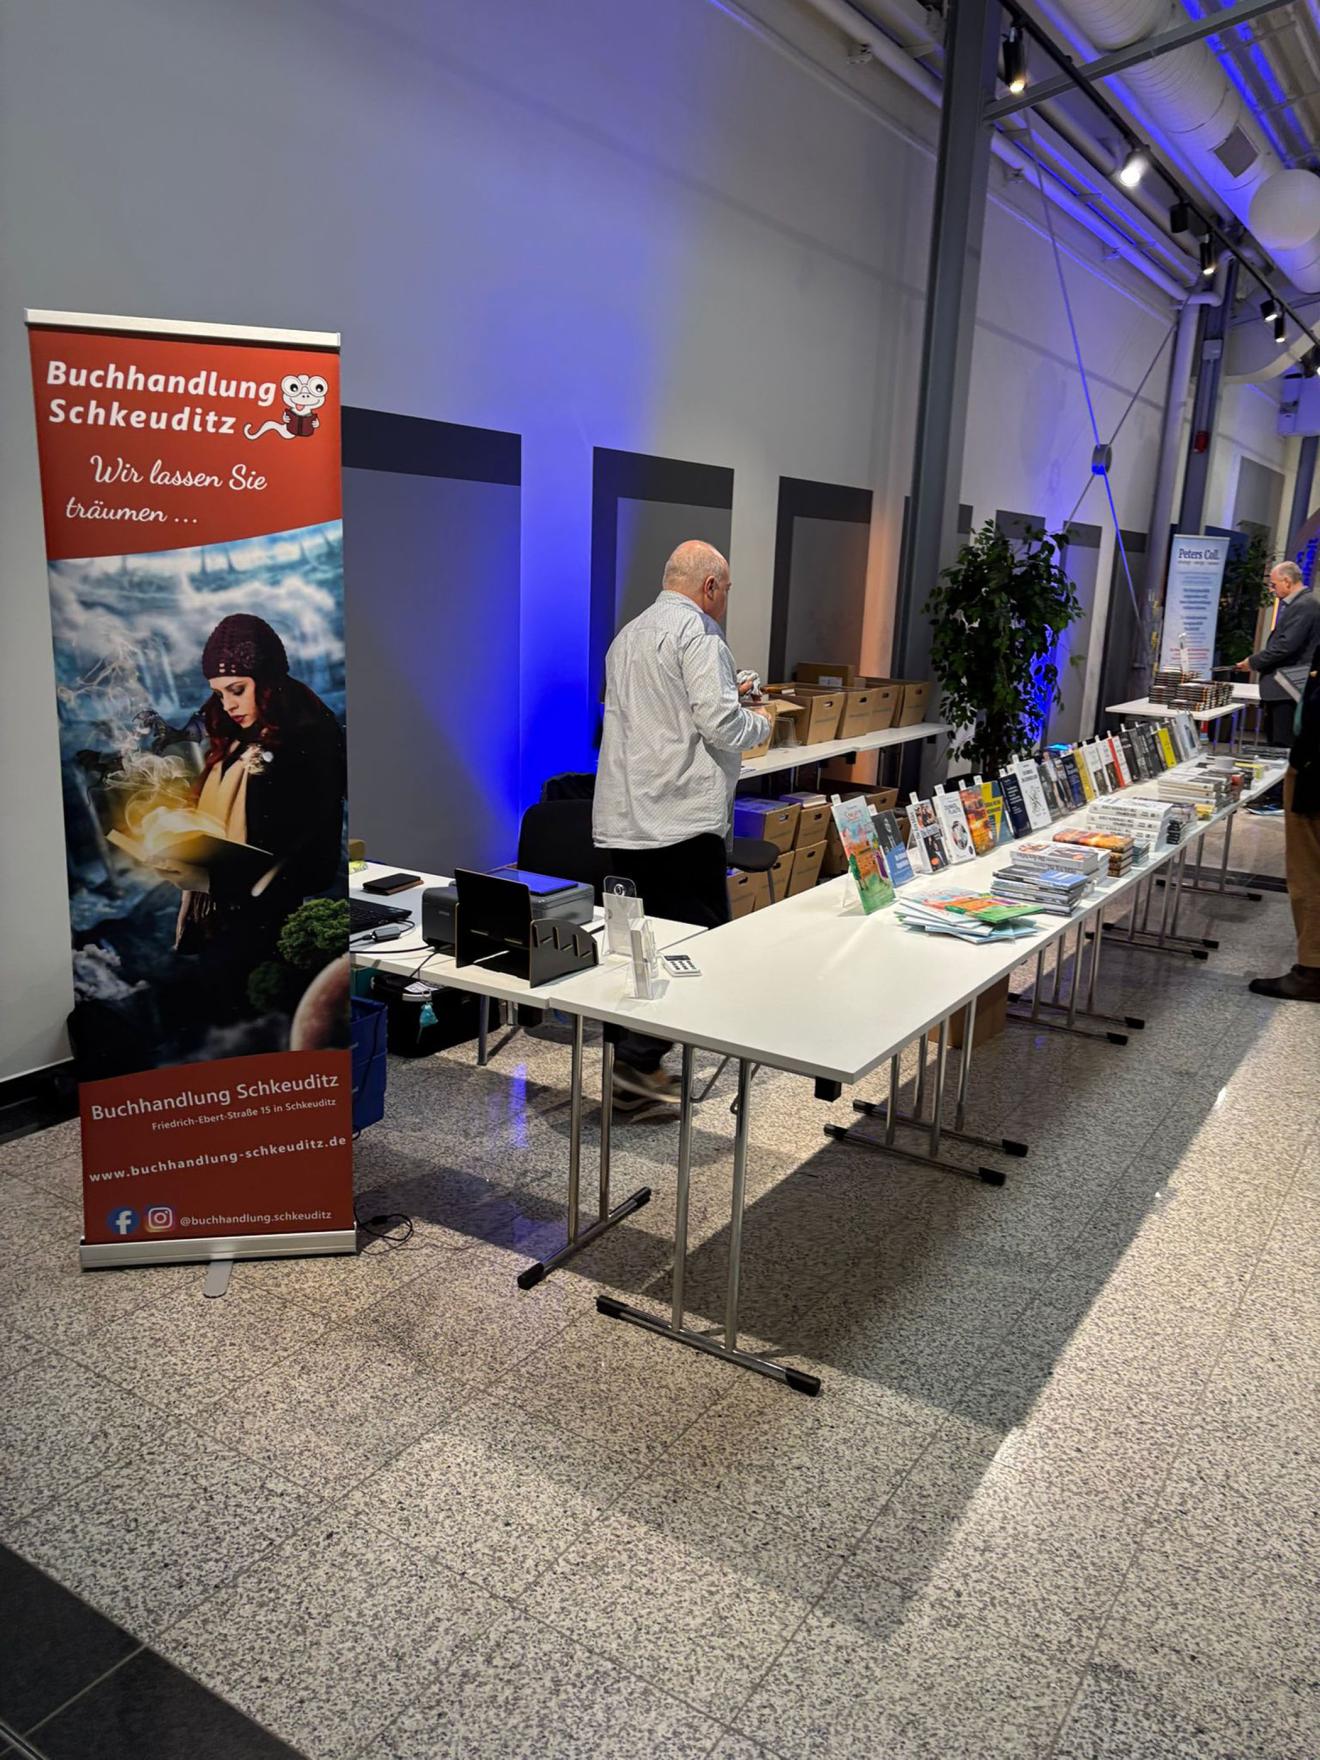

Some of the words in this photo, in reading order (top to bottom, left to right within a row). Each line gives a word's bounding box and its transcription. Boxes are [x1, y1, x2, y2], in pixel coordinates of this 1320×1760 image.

[46, 360, 277, 407] Buchhandlung
[48, 398, 237, 434] Schkeuditz
[90, 455, 143, 483] Wir
[149, 459, 223, 488] lassen
[228, 464, 268, 490] Sie
[65, 497, 168, 522] träumen
[91, 1088, 231, 1121] Buchhandlung
[236, 1073, 340, 1099] Schkeuditz
[151, 1108, 258, 1131] Friedrich-Ebert-Straße
[260, 1106, 271, 1115] 15
[273, 1103, 283, 1112] in
[285, 1098, 337, 1111] Schkeuditz
[89, 1136, 347, 1182] www.buchhandlung-schkeuditz.de
[180, 1210, 332, 1227] @buchhandlung.schkeuditz
